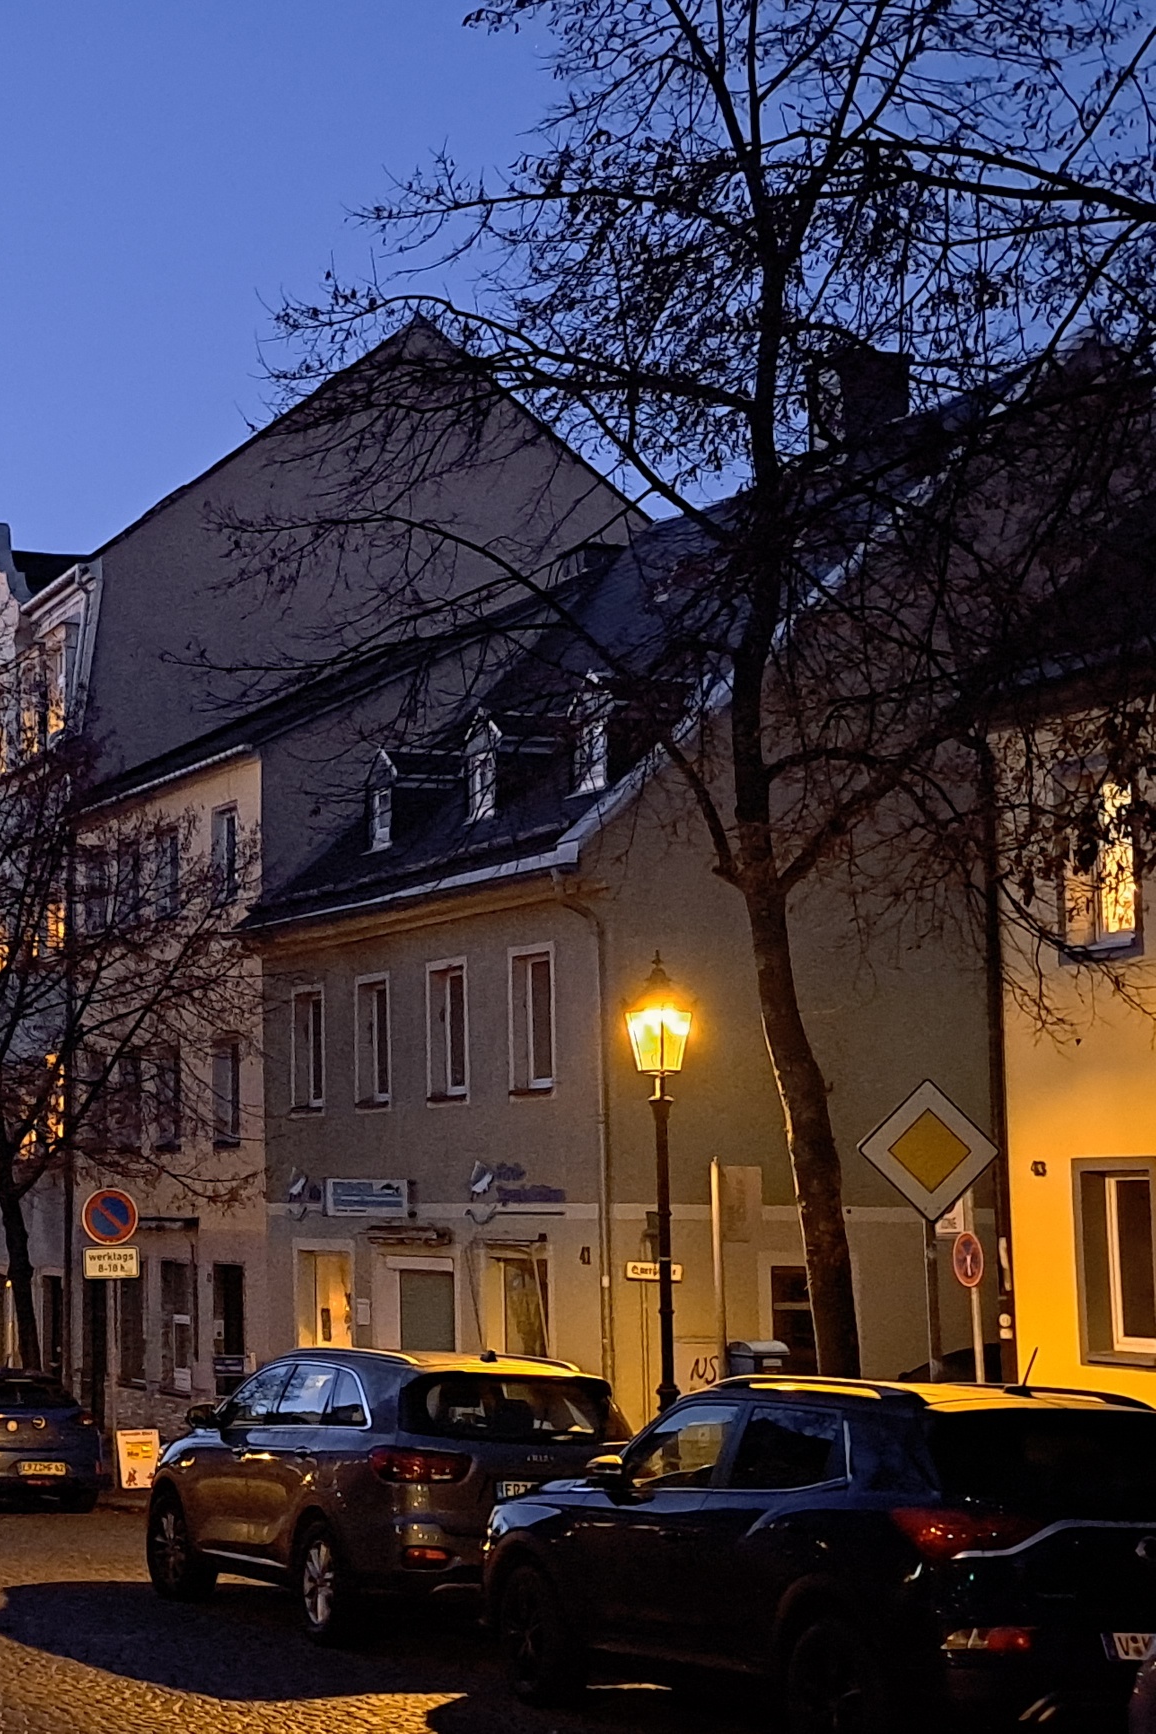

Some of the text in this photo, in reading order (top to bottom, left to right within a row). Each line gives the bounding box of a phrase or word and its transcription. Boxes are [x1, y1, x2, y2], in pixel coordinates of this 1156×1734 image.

[89, 1252, 134, 1262] werktags
[580, 1247, 591, 1265] 41
[98, 1264, 118, 1273] 8-18
[690, 1356, 719, 1385] NS
